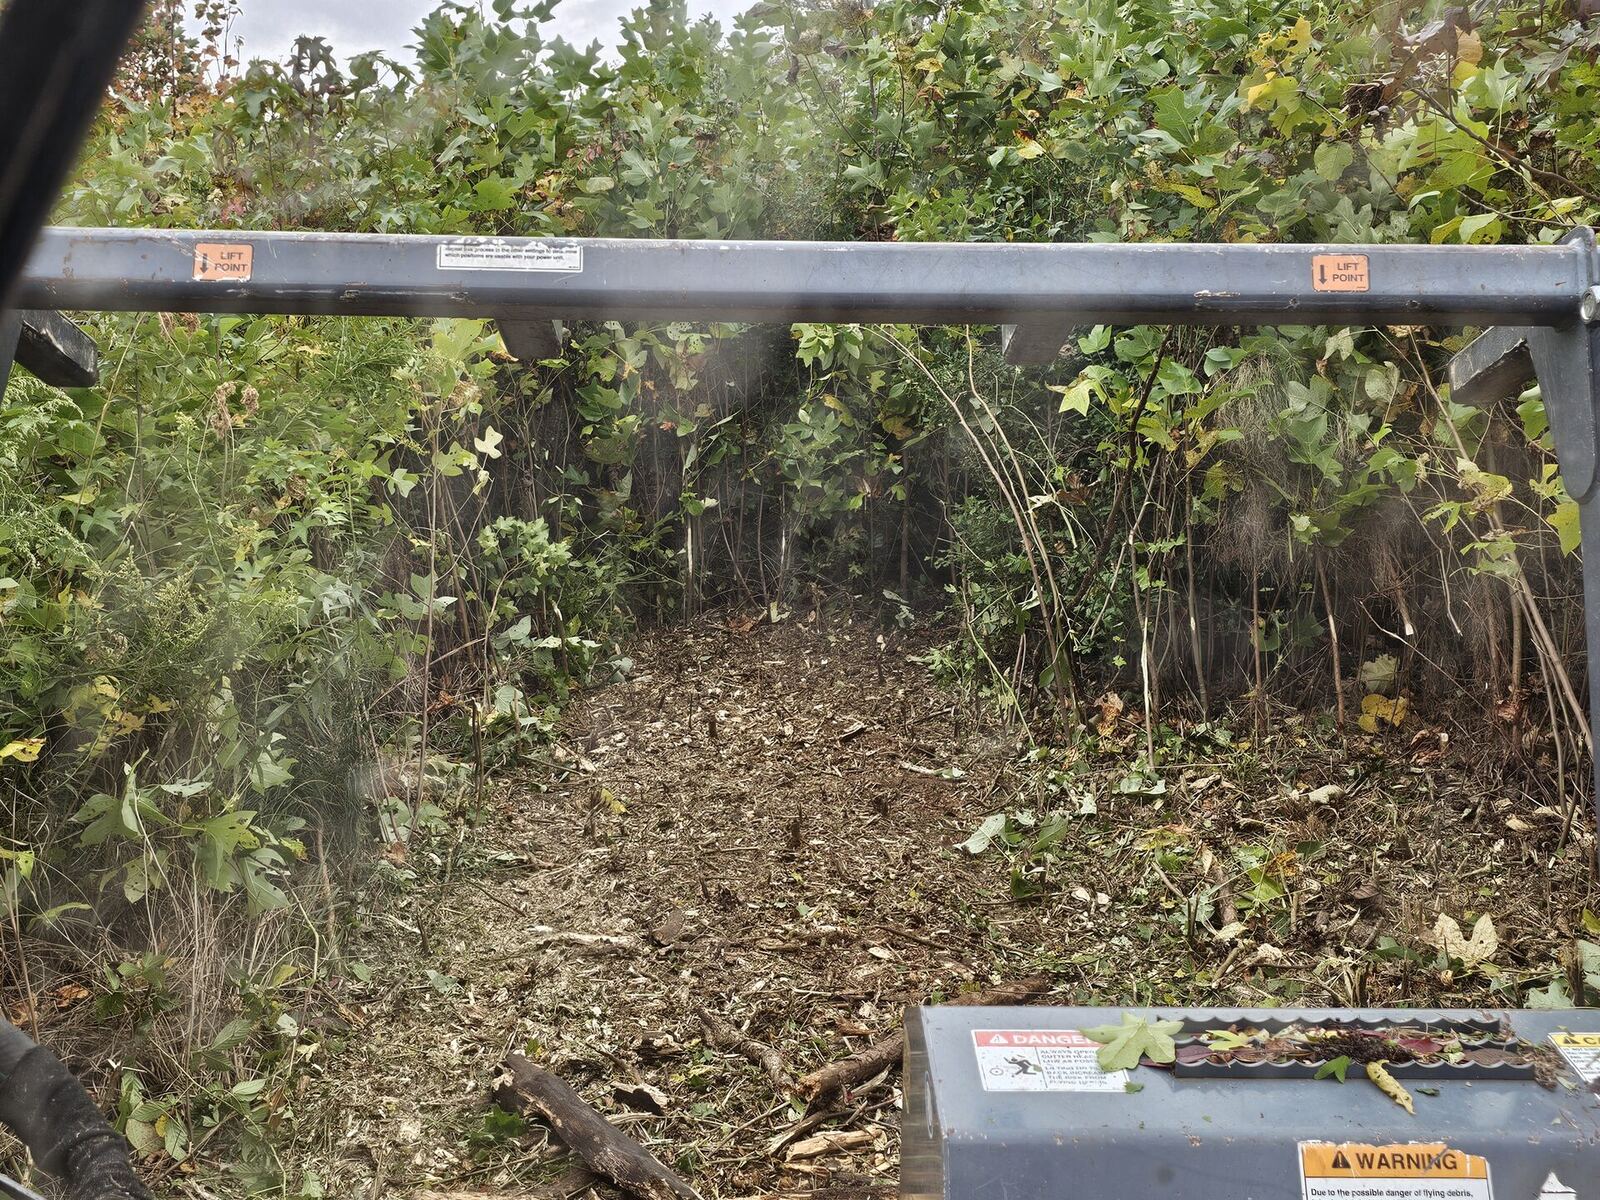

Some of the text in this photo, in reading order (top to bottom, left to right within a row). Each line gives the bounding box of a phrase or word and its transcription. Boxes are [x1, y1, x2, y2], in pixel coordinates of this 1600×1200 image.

[220, 251, 243, 260] LIFT
[214, 263, 248, 272] POINT
[1337, 262, 1359, 271] LIFT
[1332, 274, 1364, 282] POINT
[1355, 1152, 1458, 1170] WARNING
[1311, 1188, 1326, 1196] Due
[1351, 1189, 1384, 1197] possible
[1423, 1190, 1445, 1198] flying
[1447, 1190, 1474, 1198] debris,
